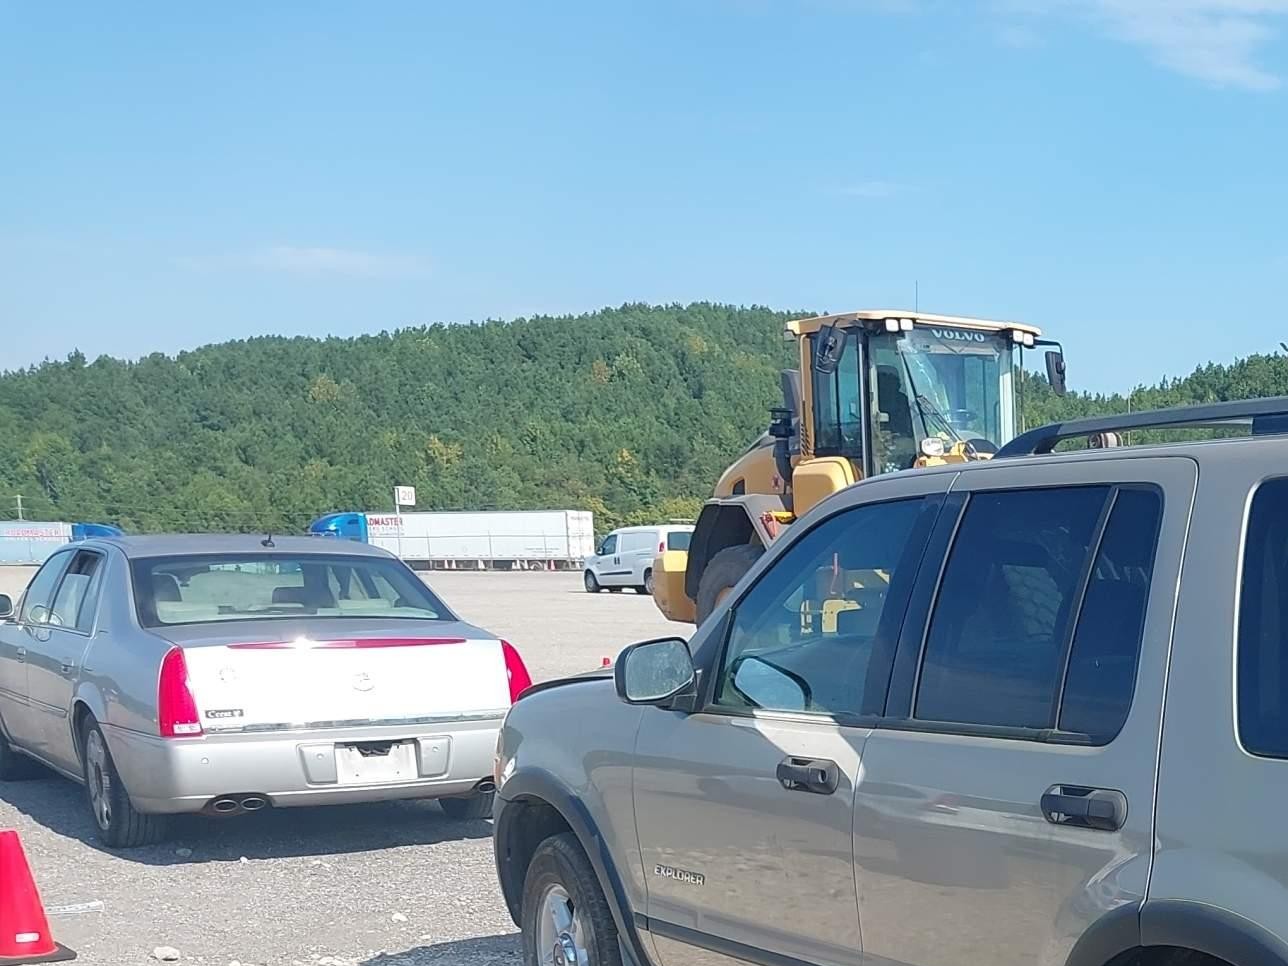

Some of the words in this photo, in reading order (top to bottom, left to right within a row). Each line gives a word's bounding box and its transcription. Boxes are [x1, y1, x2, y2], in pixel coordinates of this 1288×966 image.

[931, 329, 985, 342] VOLVO
[401, 490, 413, 501] 20
[367, 517, 403, 526] DMASTER
[655, 864, 705, 885] EXPLORER
